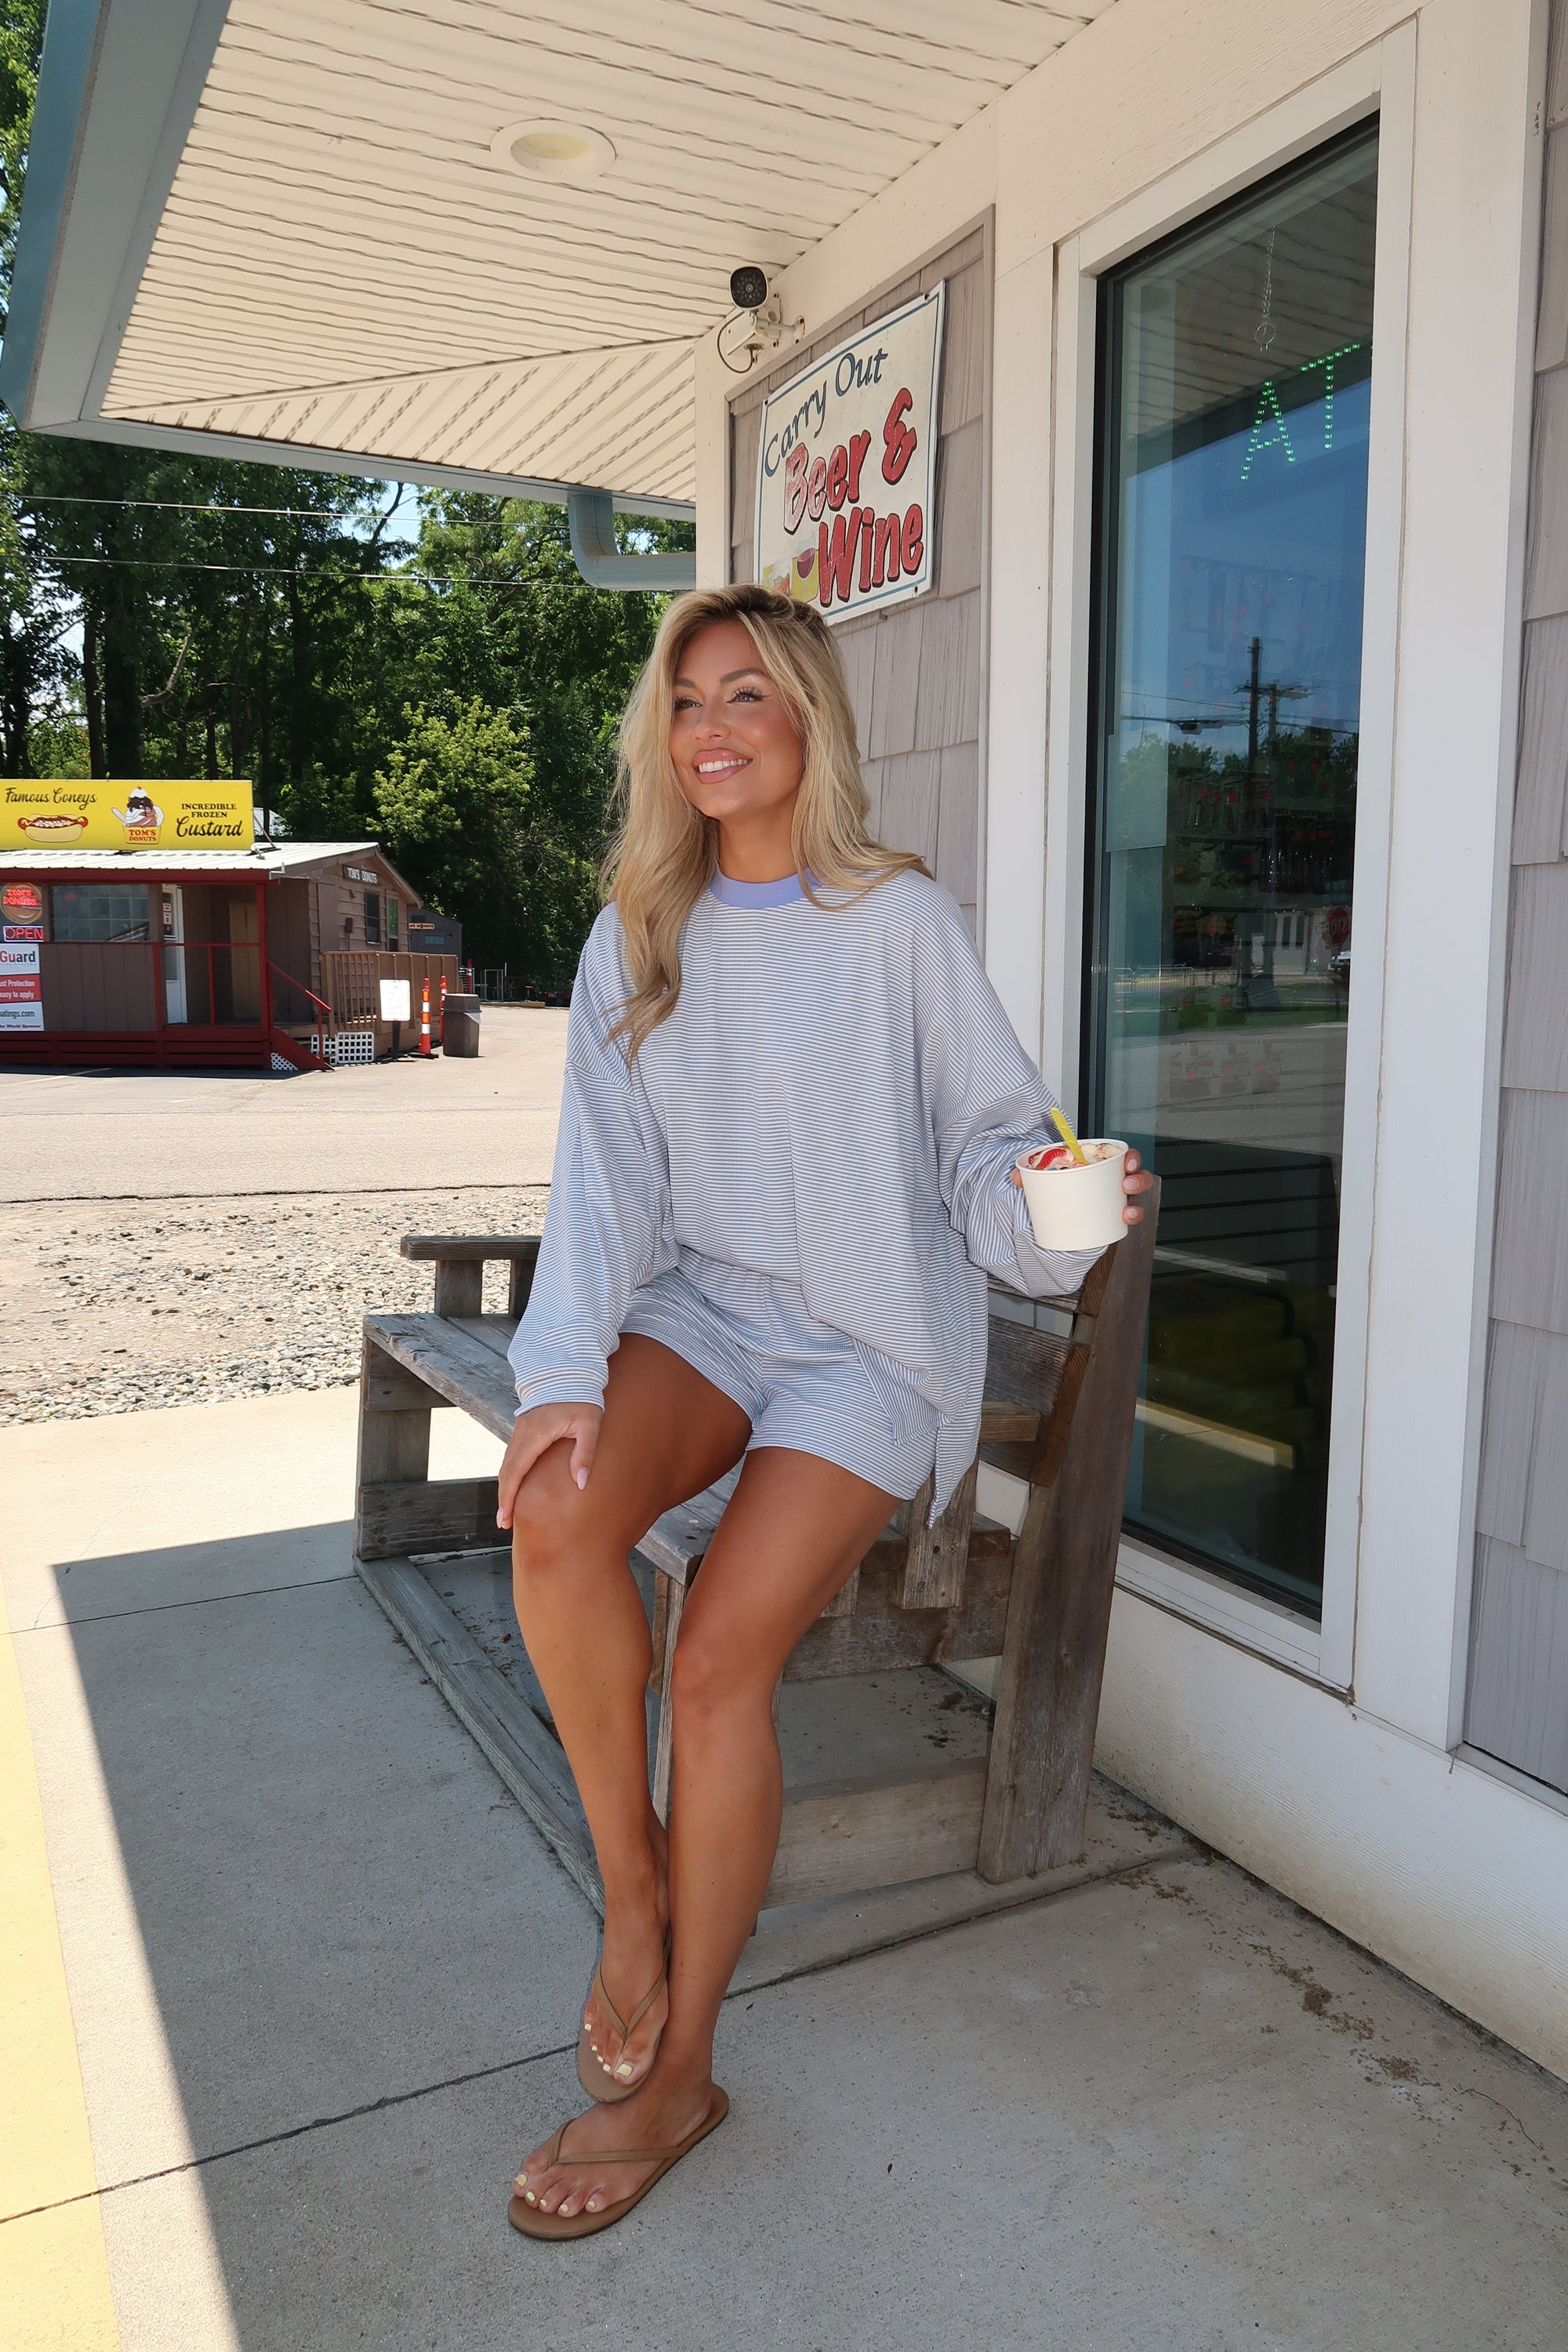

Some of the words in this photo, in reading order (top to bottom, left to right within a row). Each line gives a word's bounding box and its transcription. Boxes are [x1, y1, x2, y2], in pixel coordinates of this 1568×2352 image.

[764, 380, 827, 477] Carry
[835, 348, 888, 397] Out
[784, 430, 871, 535] Beer
[882, 387, 917, 485] &
[818, 504, 924, 608] Wine
[5, 787, 49, 804] Famous
[53, 787, 97, 811] Coneys
[176, 816, 243, 837] Custard
[347, 868, 360, 880] TOM'S
[361, 870, 377, 884] DONUTS
[5, 927, 44, 939] OPEN
[0, 950, 35, 963] Guard
[20, 991, 34, 1000] apply
